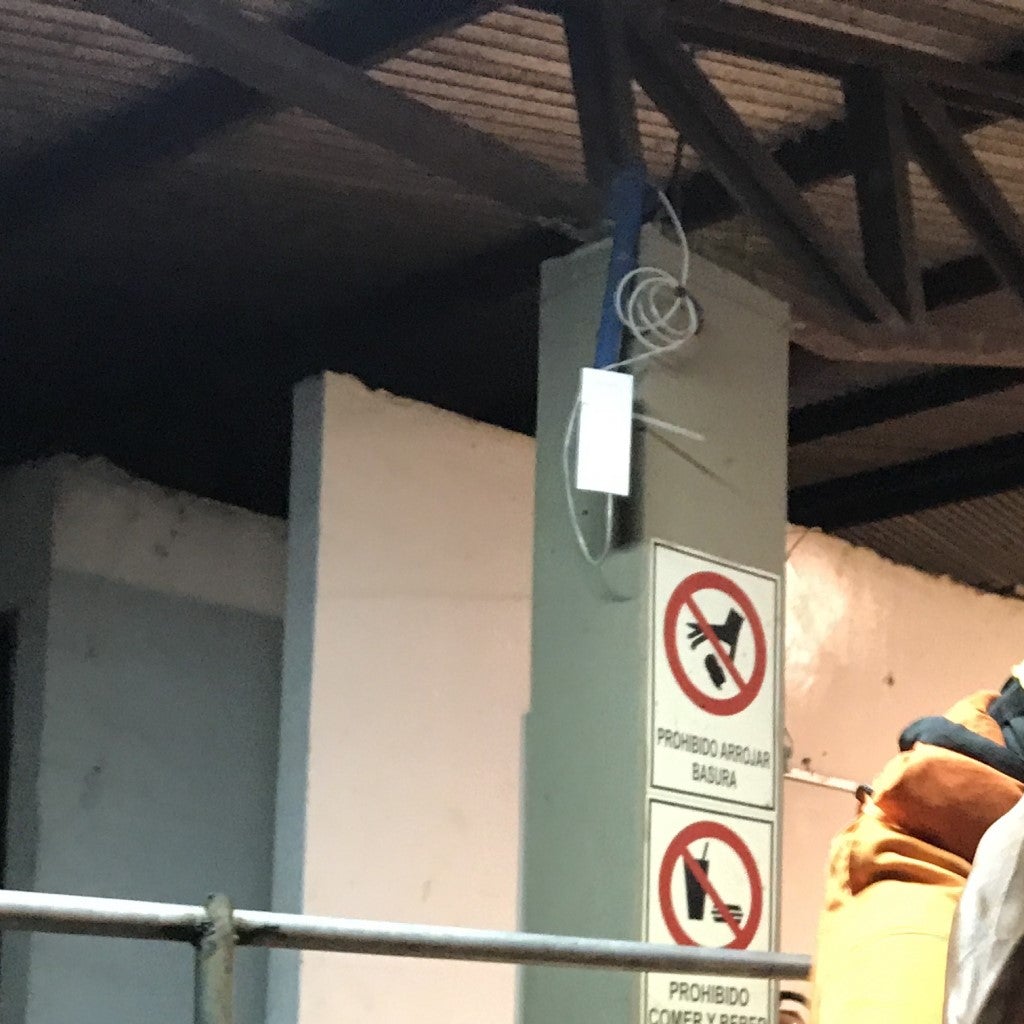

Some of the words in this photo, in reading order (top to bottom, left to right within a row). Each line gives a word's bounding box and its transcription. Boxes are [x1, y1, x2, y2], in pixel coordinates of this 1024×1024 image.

[657, 727, 719, 758] PROHIBIDO
[720, 741, 770, 769] ARROJAR
[692, 761, 737, 788] BASURA
[669, 980, 749, 1007] PROHIBIDO
